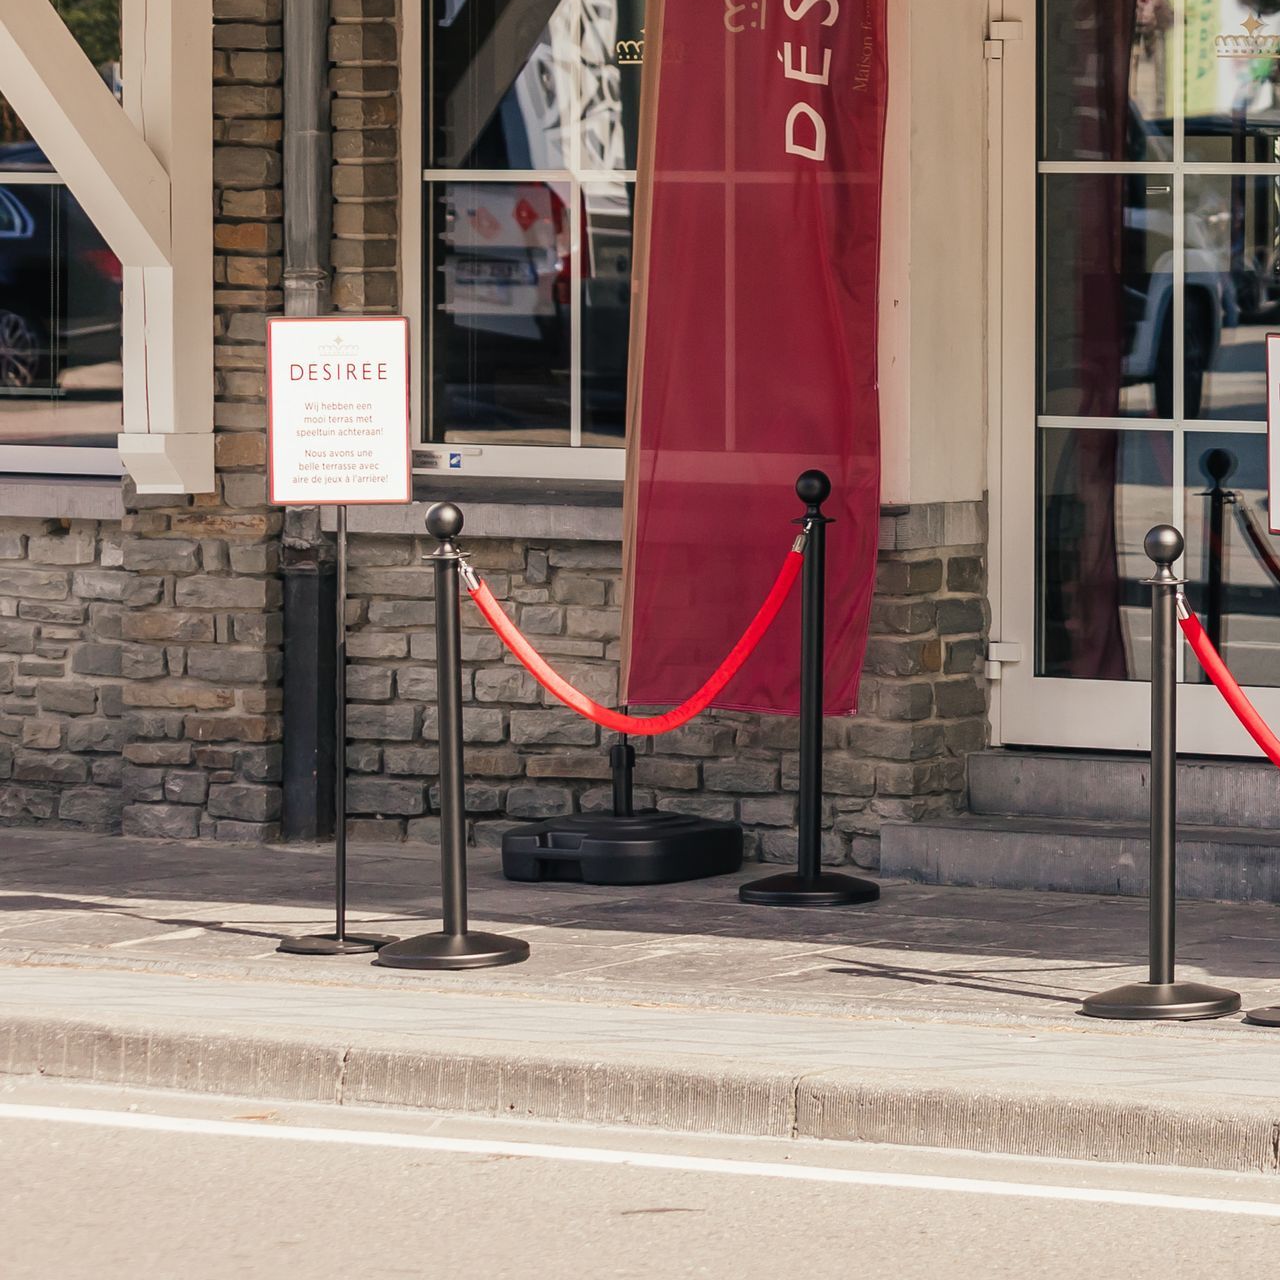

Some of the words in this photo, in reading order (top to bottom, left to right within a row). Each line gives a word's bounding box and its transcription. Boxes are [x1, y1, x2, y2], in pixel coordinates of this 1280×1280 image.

[852, 35, 874, 93] Maison
[321, 402, 354, 411] hebben
[304, 416, 326, 424] mooi
[356, 415, 373, 423] met
[296, 427, 336, 437] speeltuin
[305, 449, 327, 457] Nous
[299, 462, 320, 471] belle
[322, 463, 357, 471] terrasse
[311, 475, 322, 483] de
